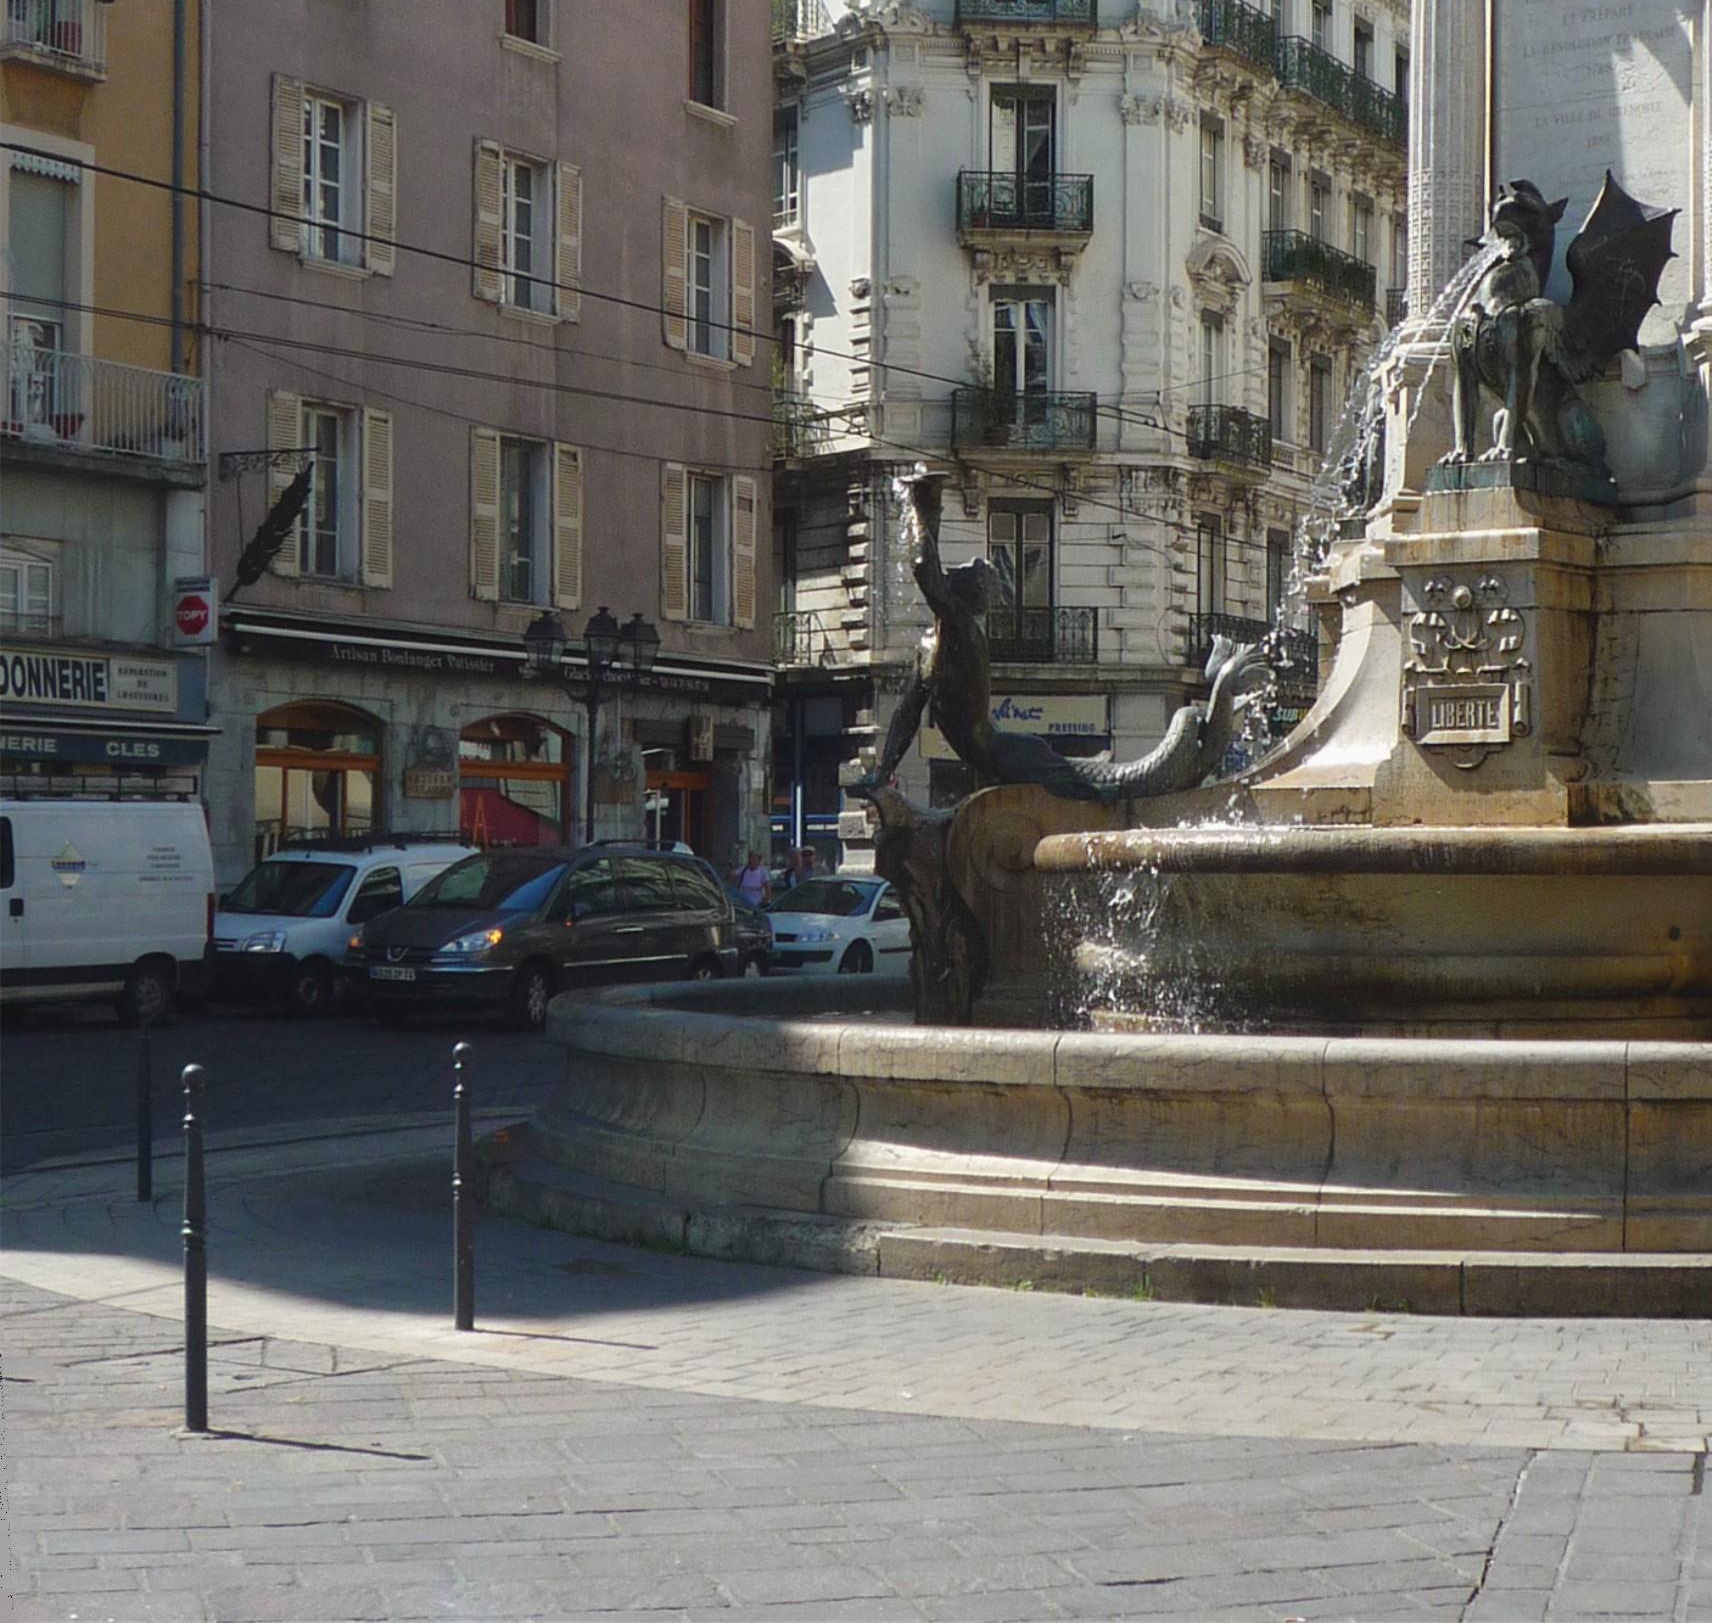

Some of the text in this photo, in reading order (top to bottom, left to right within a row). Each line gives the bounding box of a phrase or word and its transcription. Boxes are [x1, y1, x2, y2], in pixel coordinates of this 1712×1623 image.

[178, 609, 207, 621] TOPY
[331, 644, 377, 663] Artisan
[382, 648, 442, 668] Boulanger
[1431, 700, 1497, 728] LIBERTE
[1049, 723, 1096, 733] PRESSING
[106, 741, 160, 758] CLES
